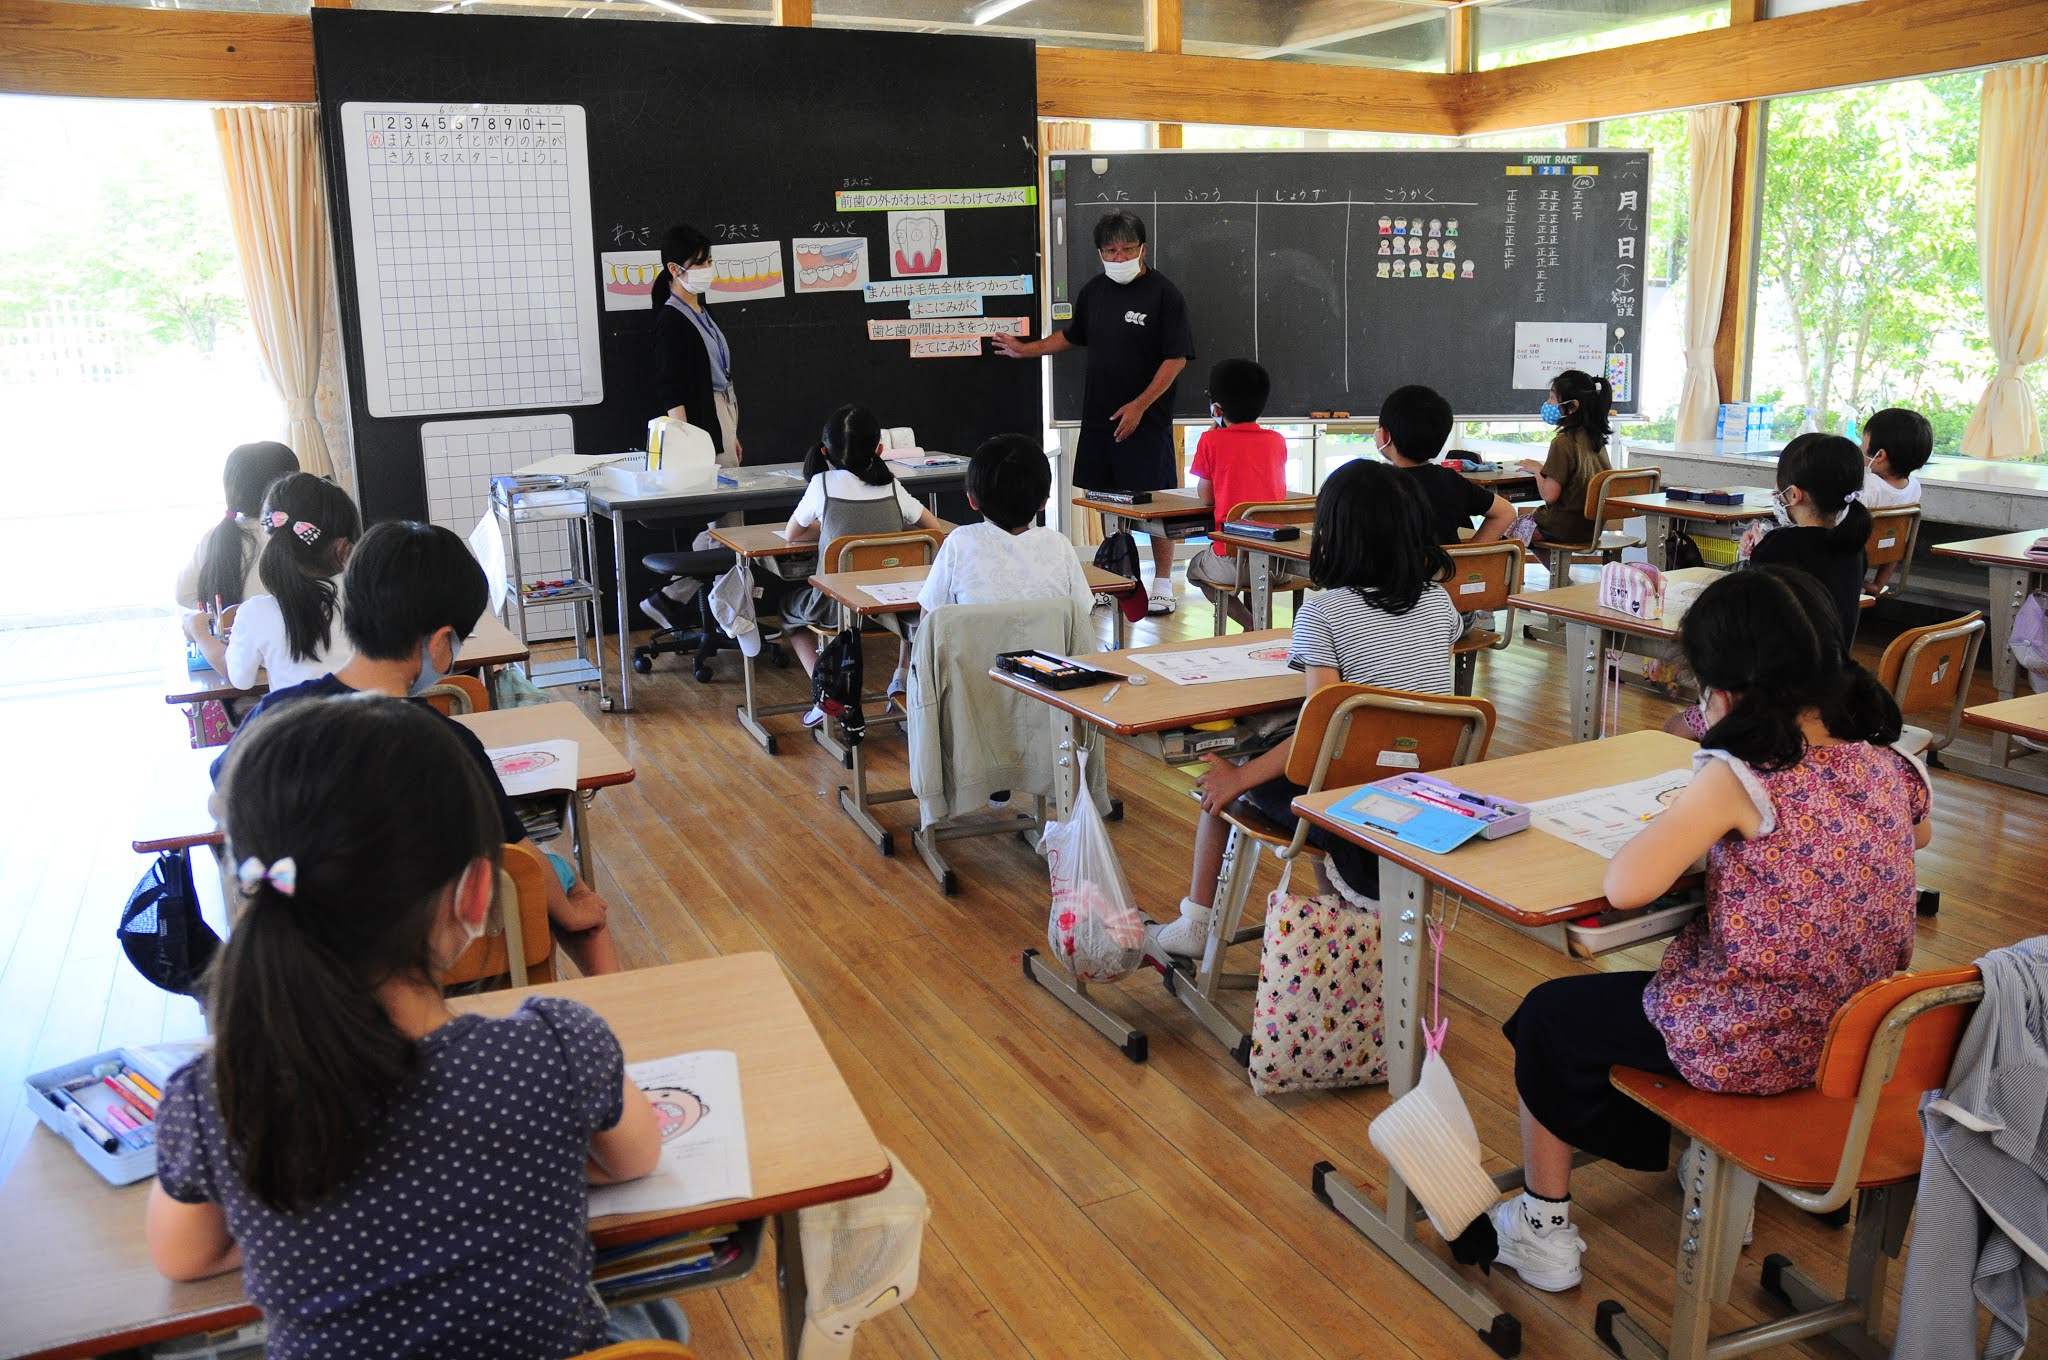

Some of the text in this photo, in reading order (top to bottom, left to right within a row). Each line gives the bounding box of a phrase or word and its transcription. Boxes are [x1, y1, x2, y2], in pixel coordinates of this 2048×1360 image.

[372, 117, 377, 128] 1
[387, 117, 396, 129] 2
[404, 117, 413, 129] 3
[421, 117, 430, 129] 4
[439, 117, 447, 129] 5
[455, 117, 463, 129] 6
[471, 118, 479, 129] 7
[488, 118, 496, 129] 8
[504, 118, 512, 129] 9
[519, 118, 531, 130] 10
[1527, 155, 1577, 164] POINT RACE
[840, 190, 1025, 208] 前歯の外がわは3つにわけてみがく
[1097, 190, 1130, 201] へた
[1184, 189, 1222, 202] ふつう
[1275, 189, 1327, 202] じょうず
[1384, 188, 1434, 203] ごうかく
[612, 223, 651, 247] わき
[715, 223, 760, 239] つまさき
[812, 220, 857, 235] かかと
[868, 279, 1024, 299] まん中は毛先全体をつかって、
[914, 300, 978, 315] よこにみがく
[872, 320, 1021, 338] 歯と歯の間はわきをつかって
[913, 340, 979, 354] たてにみがく
